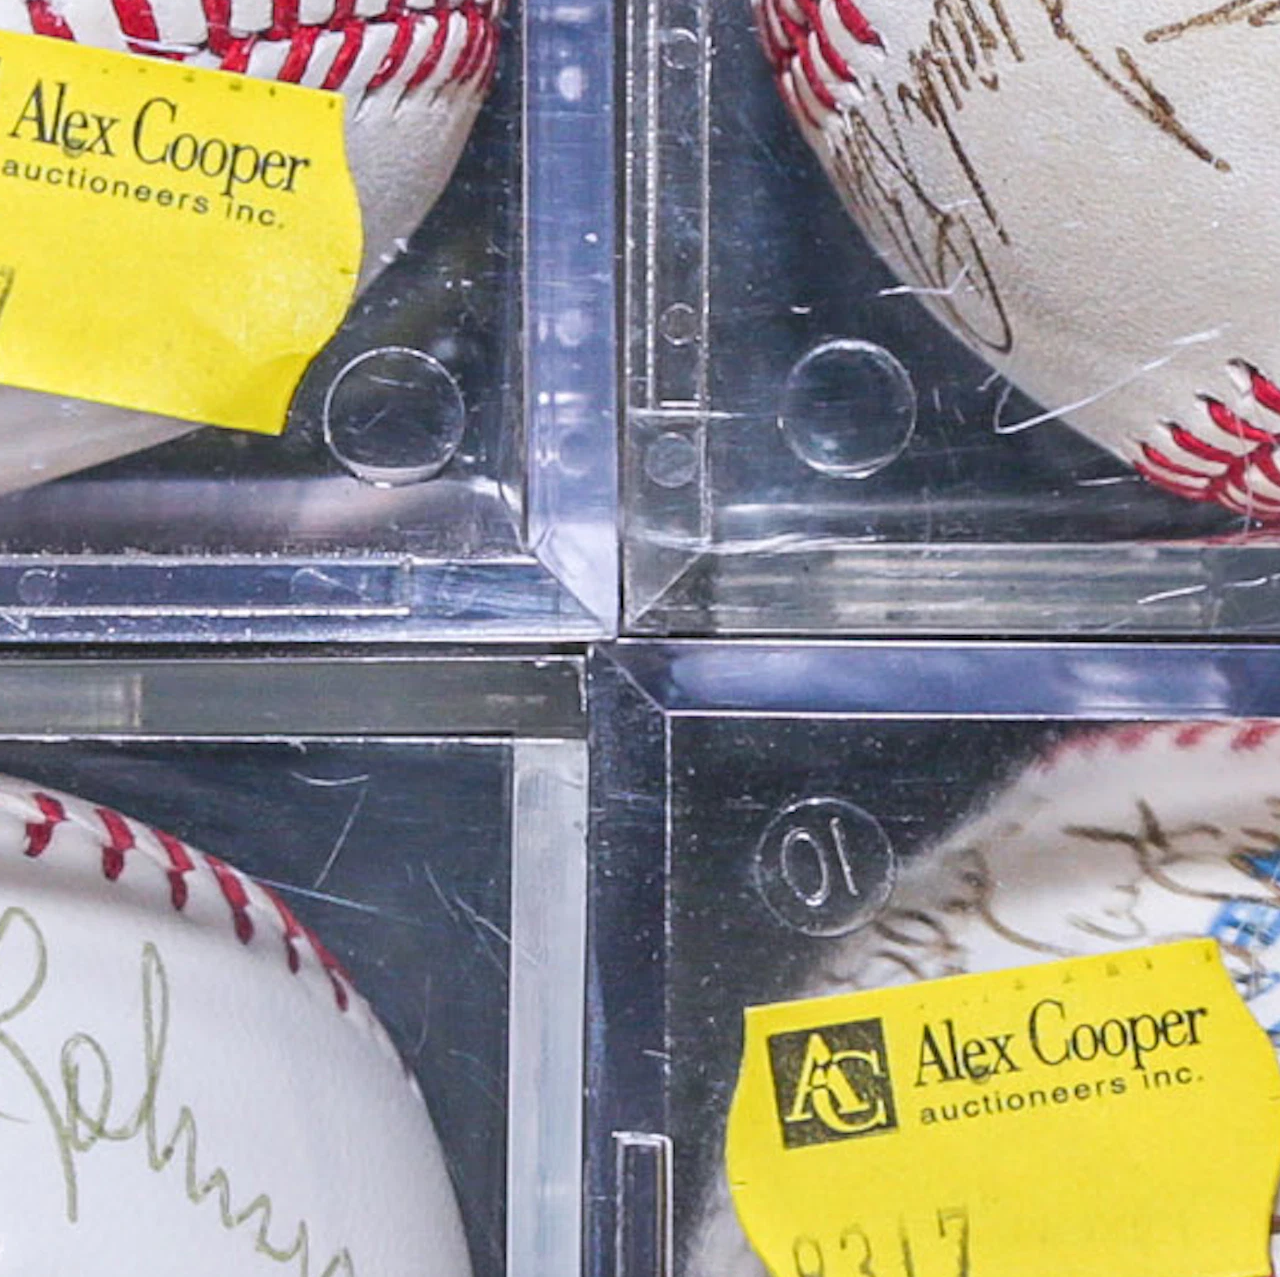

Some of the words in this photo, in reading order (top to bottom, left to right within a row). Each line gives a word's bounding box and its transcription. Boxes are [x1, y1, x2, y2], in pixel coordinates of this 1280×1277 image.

[7, 79, 120, 158] Alex
[131, 97, 313, 198] Cooper
[0, 159, 211, 216] auctioneers
[224, 199, 286, 230] inc.
[913, 1018, 1021, 1088] Alex
[1027, 998, 1209, 1072] Cooper
[919, 1075, 1127, 1126] auctioneers
[1143, 1066, 1205, 1091] inc.
